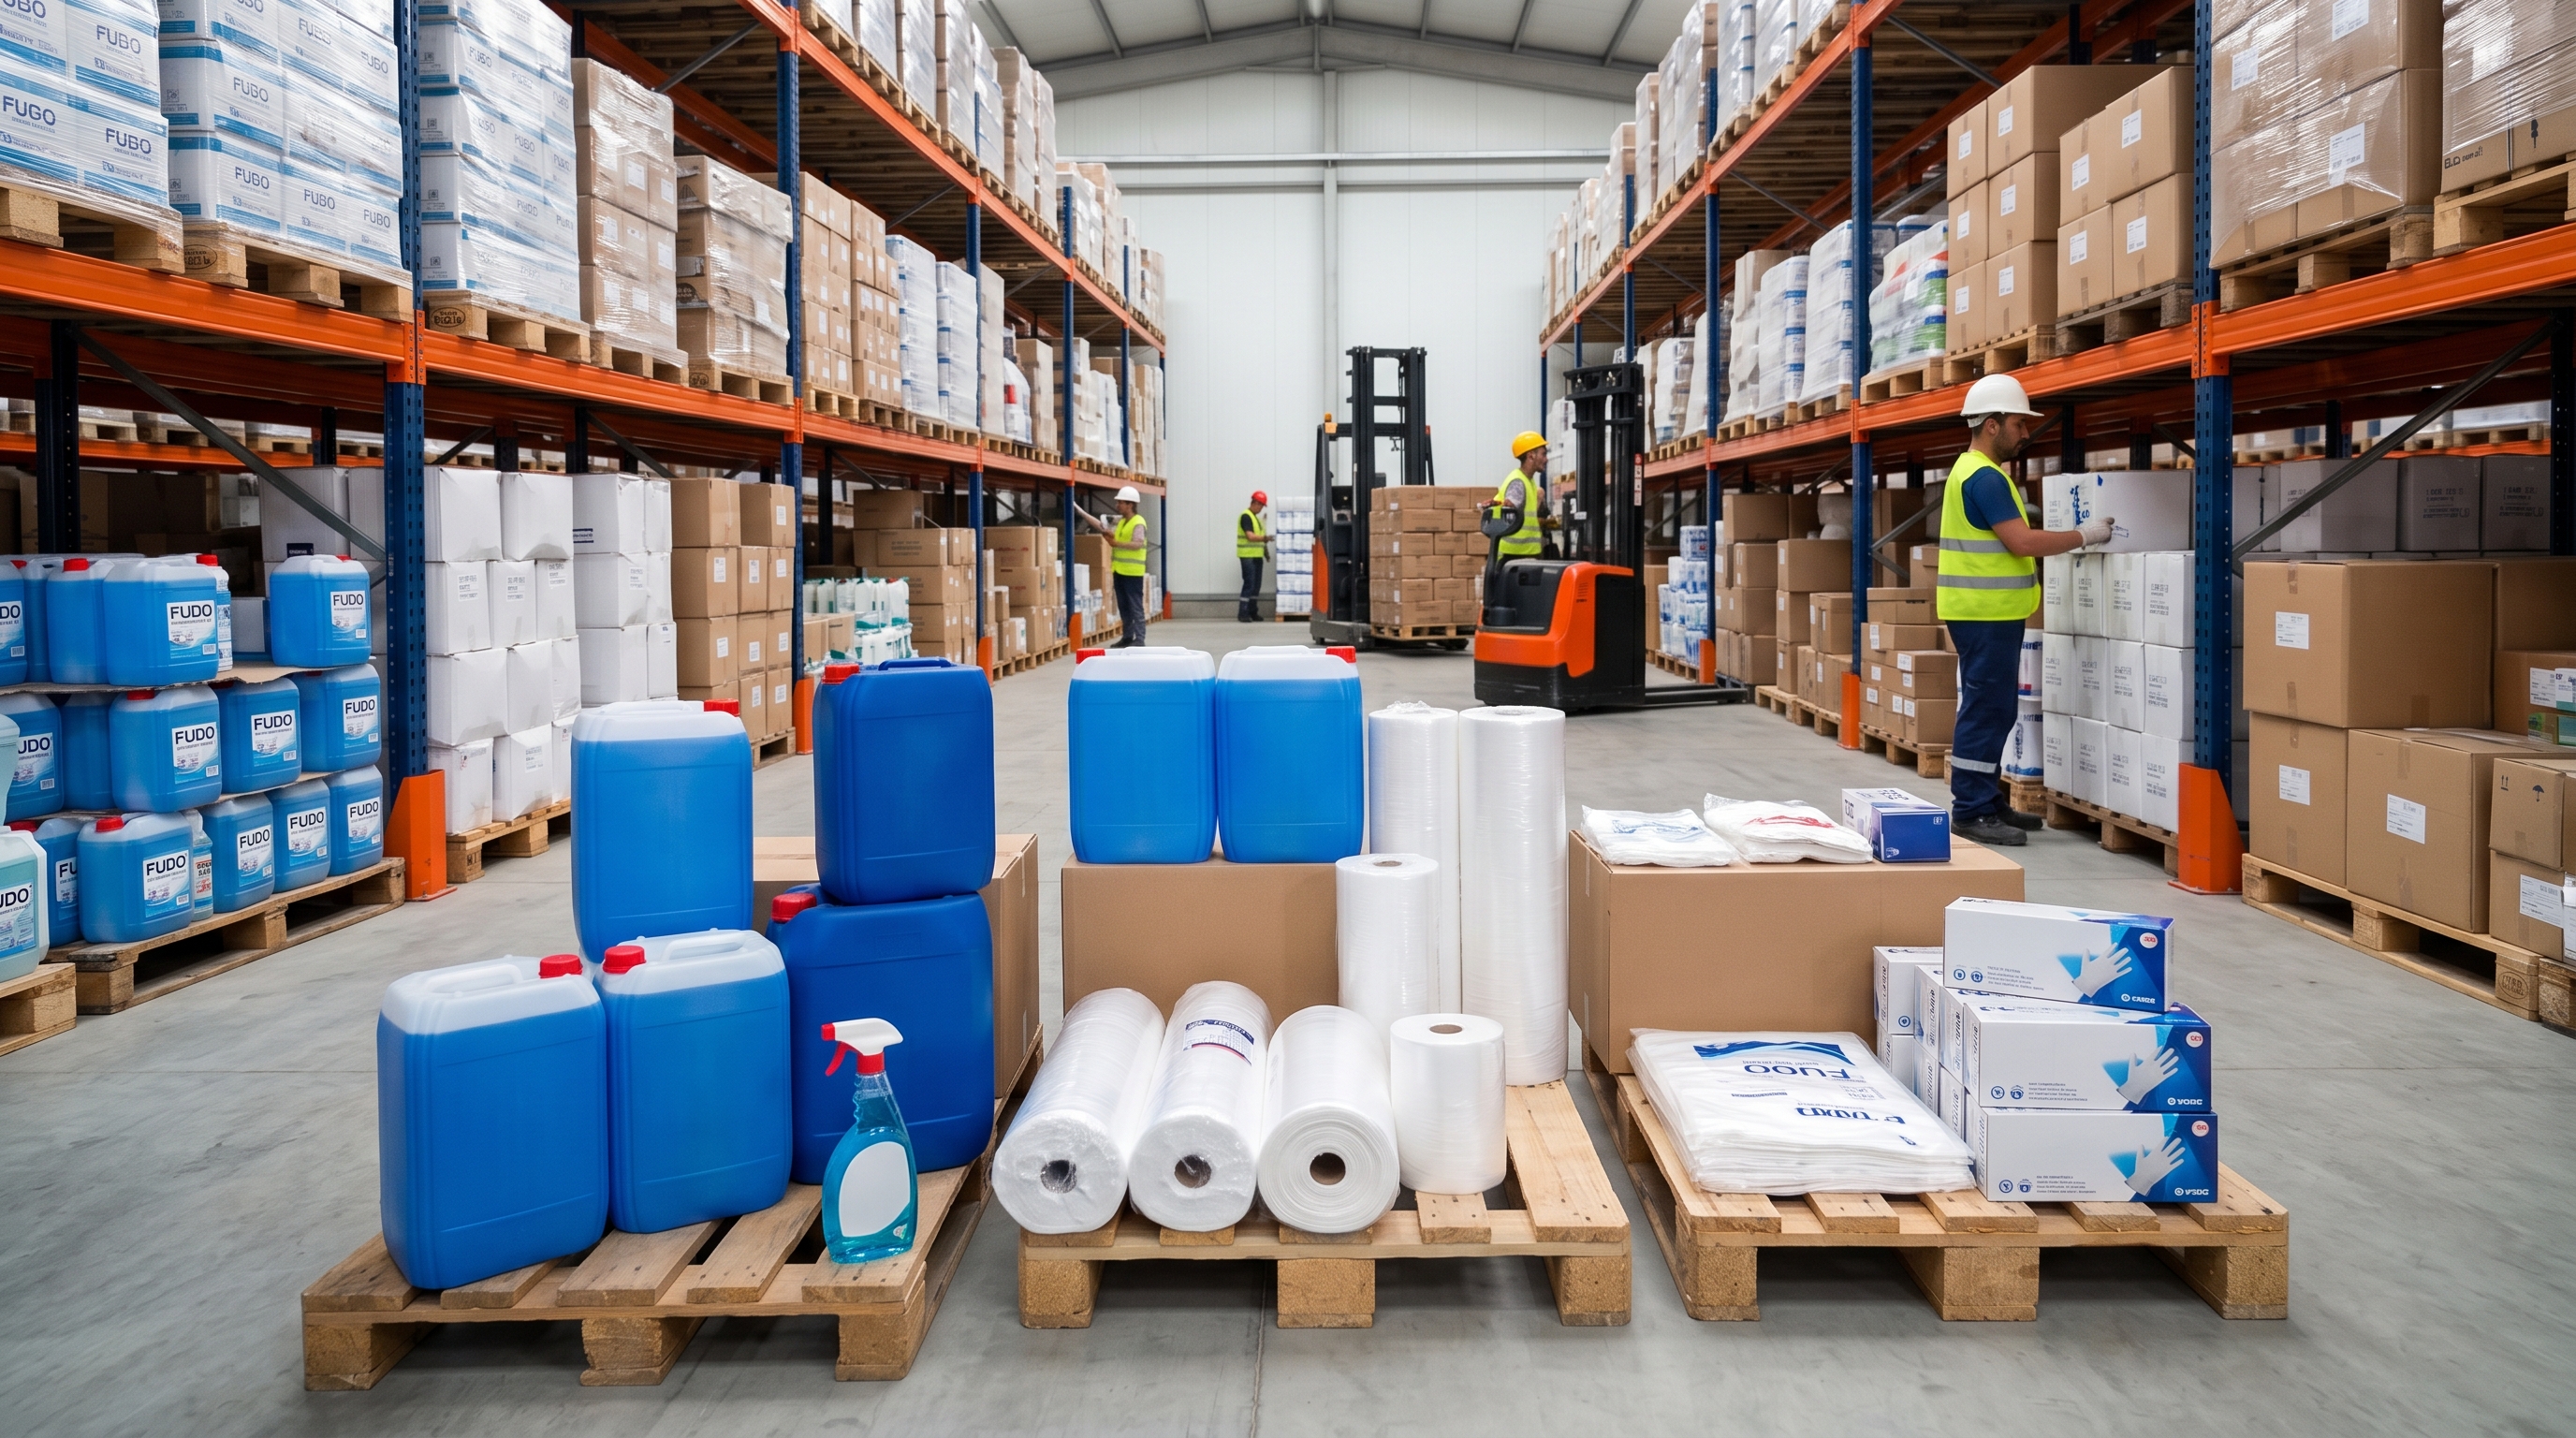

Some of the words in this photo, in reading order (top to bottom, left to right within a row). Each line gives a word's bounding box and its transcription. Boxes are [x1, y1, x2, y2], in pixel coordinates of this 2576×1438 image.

[96, 24, 141, 54] FUBO
[233, 77, 269, 102] FUBO
[106, 127, 152, 154] FUBO
[303, 188, 335, 210] FUBO
[363, 209, 390, 228] FUBO
[332, 594, 364, 607] FUDO
[0, 605, 21, 619] DO
[170, 604, 212, 620] FUDO
[345, 698, 375, 714] FUDO
[254, 713, 293, 731] FUDO
[175, 726, 215, 745] FUDO
[18, 736, 51, 755] UDO
[349, 800, 379, 818] FUDO
[289, 811, 325, 829] FUDO
[240, 829, 271, 849] FUDO
[59, 861, 78, 878] FU
[146, 855, 186, 876] FUDO
